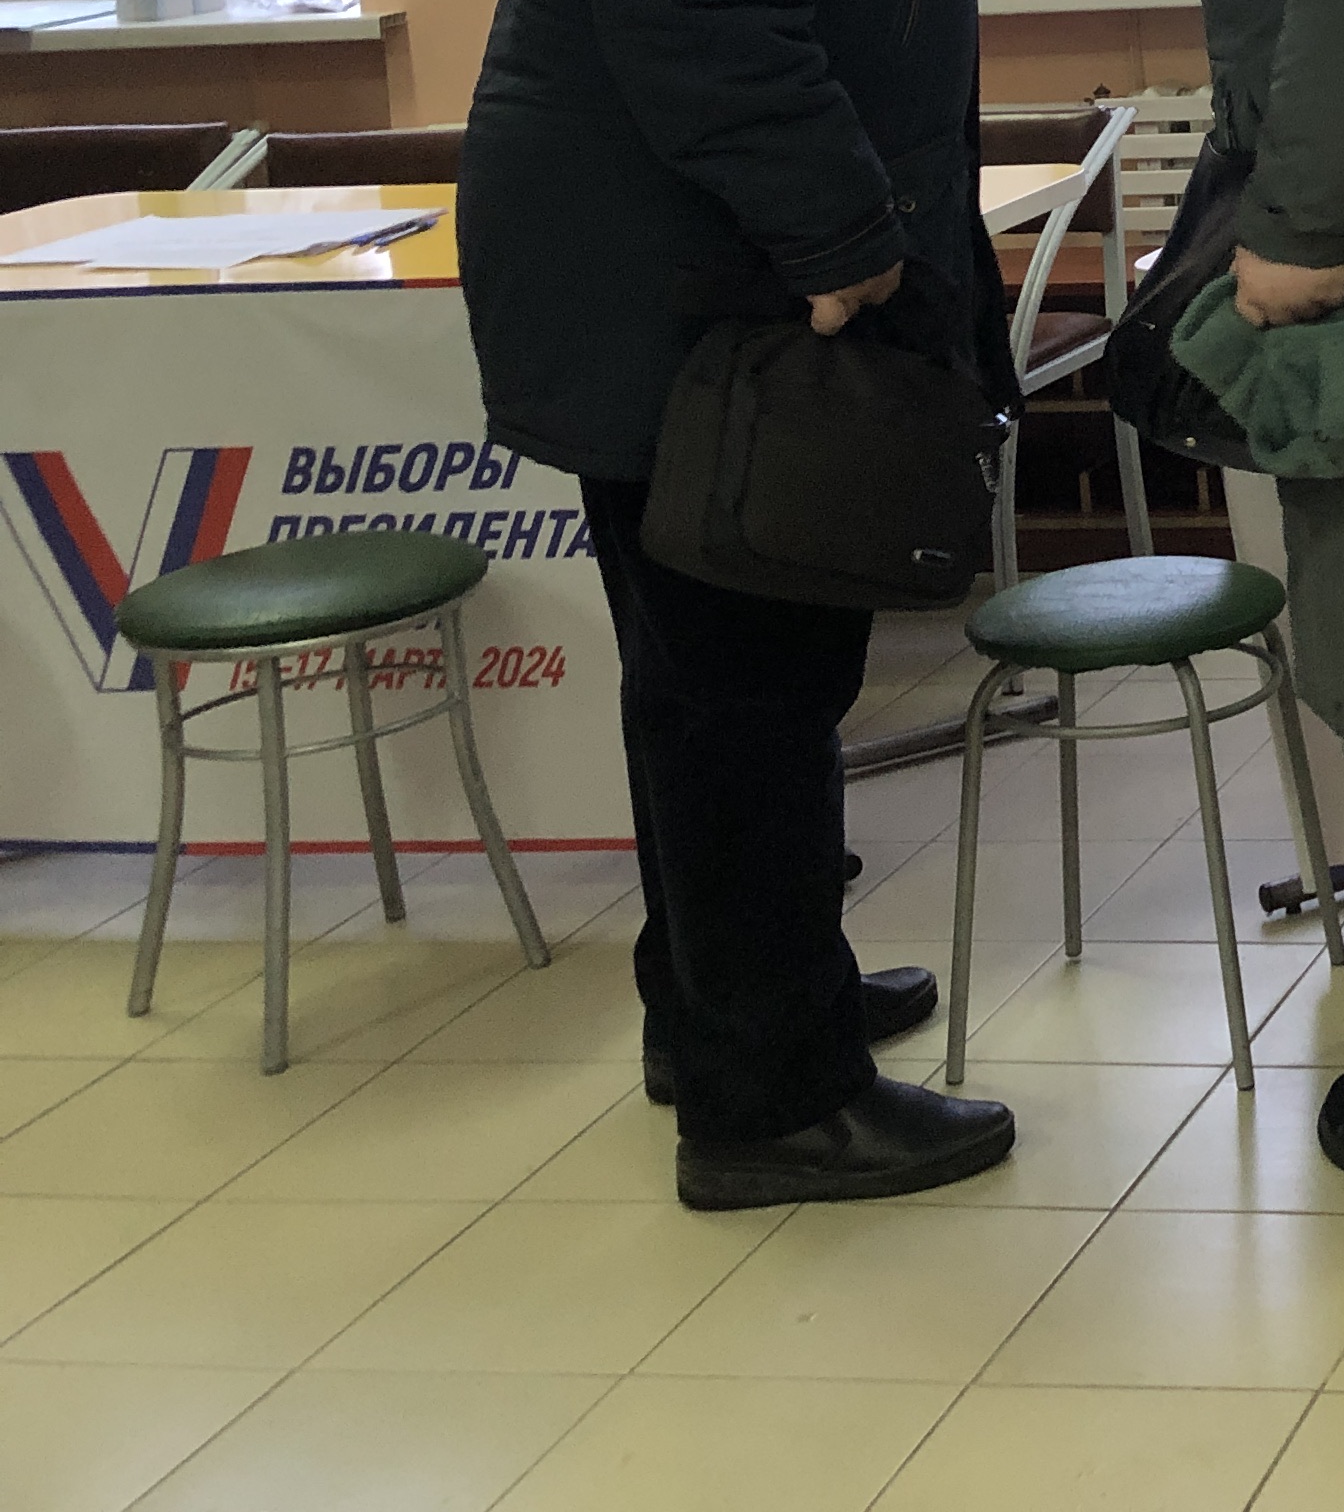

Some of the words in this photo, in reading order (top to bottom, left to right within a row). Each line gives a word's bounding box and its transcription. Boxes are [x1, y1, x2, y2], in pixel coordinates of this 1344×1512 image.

[281, 439, 522, 495] ВЫБОРЫ
[335, 646, 450, 691] АРТ
[473, 645, 567, 690] 2024
